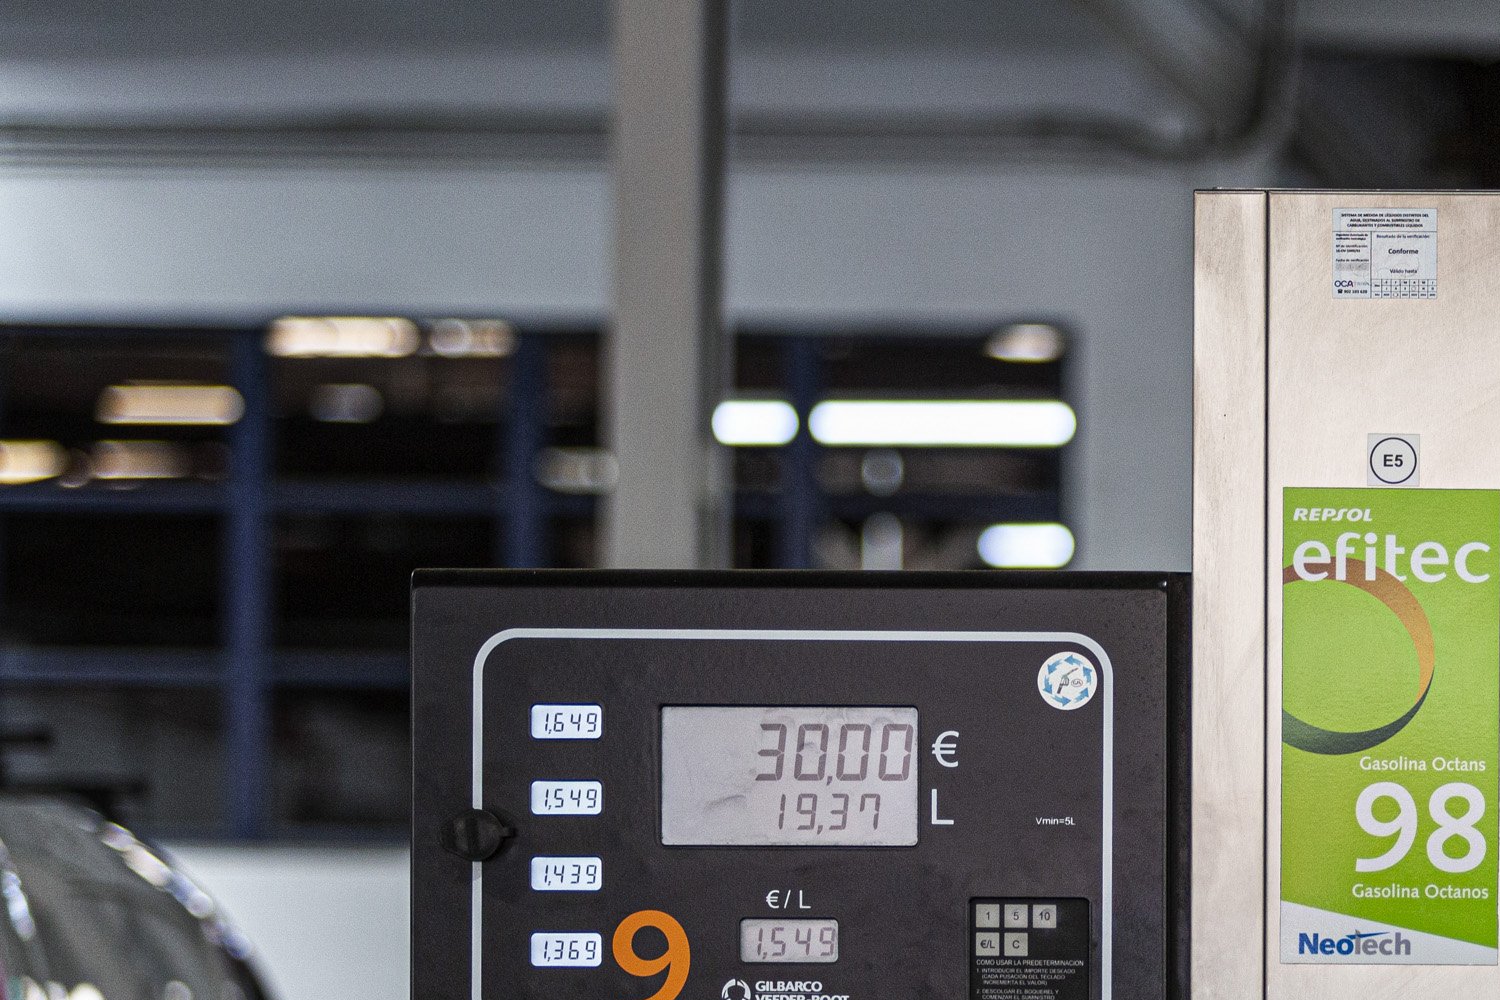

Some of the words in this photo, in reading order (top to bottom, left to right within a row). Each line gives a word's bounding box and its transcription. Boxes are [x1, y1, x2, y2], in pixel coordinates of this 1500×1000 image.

[1383, 454, 1403, 468] E5
[1293, 507, 1372, 521] REPSOL
[1293, 532, 1491, 584] efitec
[545, 713, 597, 734] 1,649
[755, 723, 913, 785] 30,00
[932, 730, 959, 767] €
[1360, 756, 1426, 771] Gasolina
[1431, 756, 1486, 772] Octans
[545, 789, 597, 810] 1,549
[932, 789, 954, 824] L
[778, 794, 880, 835] 19,37
[1035, 817, 1076, 825] Vmin=5L
[1355, 782, 1487, 873] 98
[544, 864, 597, 886] 1,439
[1352, 884, 1419, 899] Gasolina
[1425, 884, 1489, 899] Octanos
[986, 912, 990, 920] 1
[1013, 912, 1019, 920] 5
[1039, 912, 1050, 920] 10
[543, 941, 596, 962] 1,369
[757, 927, 836, 959] 1,549
[980, 940, 995, 949] €/L
[1012, 940, 1020, 949] C
[1298, 930, 1411, 956] NeoTech
[755, 981, 822, 992] GILBARCO
